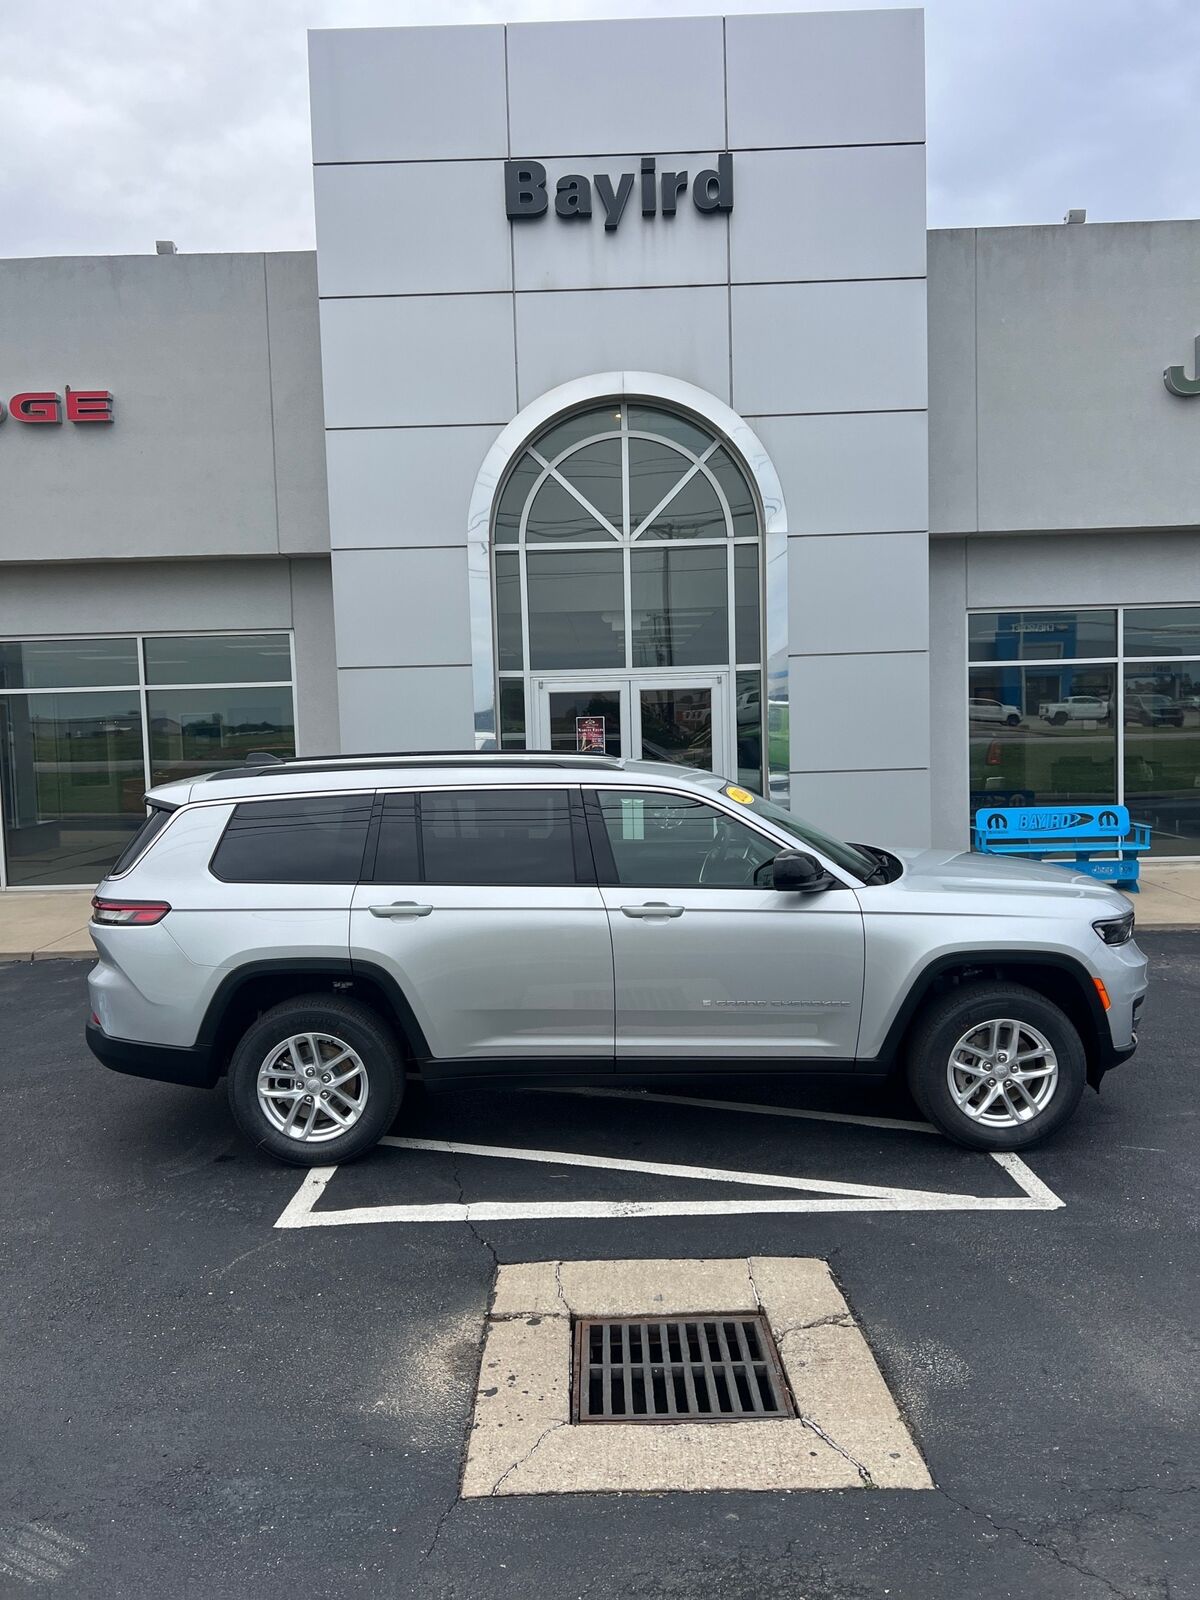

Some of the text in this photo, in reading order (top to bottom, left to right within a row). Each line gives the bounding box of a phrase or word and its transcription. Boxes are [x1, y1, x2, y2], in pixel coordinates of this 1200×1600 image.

[504, 153, 734, 231] Bayird
[0, 390, 115, 425] GE
[1020, 813, 1072, 830] BAYIRD
[715, 999, 851, 1008] GRAND CHEROKEE
